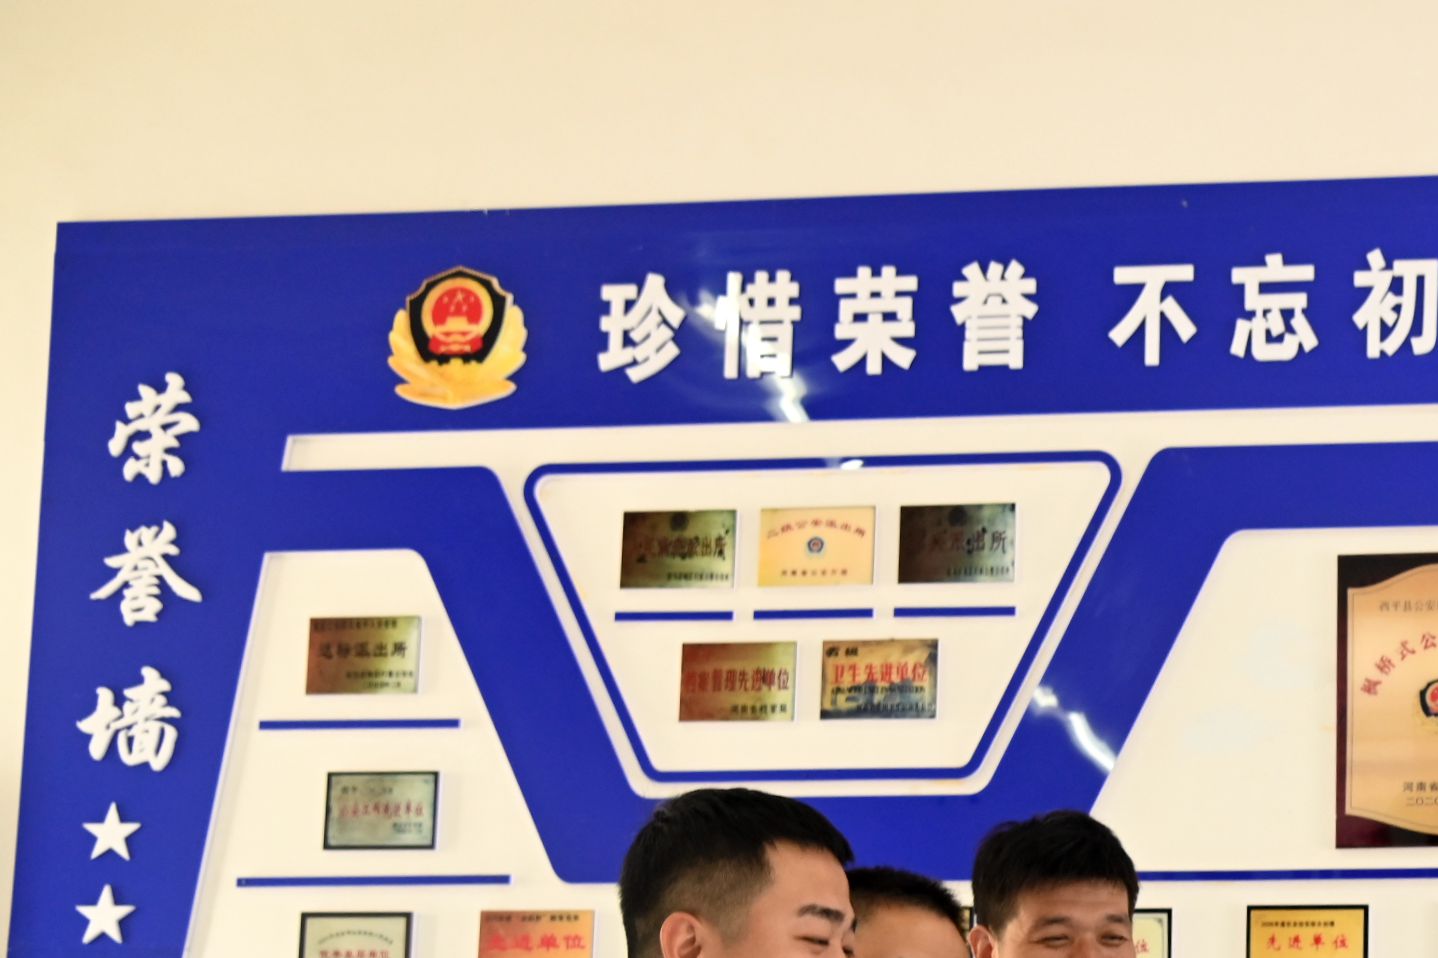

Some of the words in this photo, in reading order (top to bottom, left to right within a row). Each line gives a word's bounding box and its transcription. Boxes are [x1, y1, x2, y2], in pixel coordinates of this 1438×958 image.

[596, 258, 1039, 383] 珍惜荣誉
[77, 371, 202, 772] 荣誉墙
[832, 660, 928, 685] 卫生先进单位
[1265, 932, 1350, 951] 先进单位
